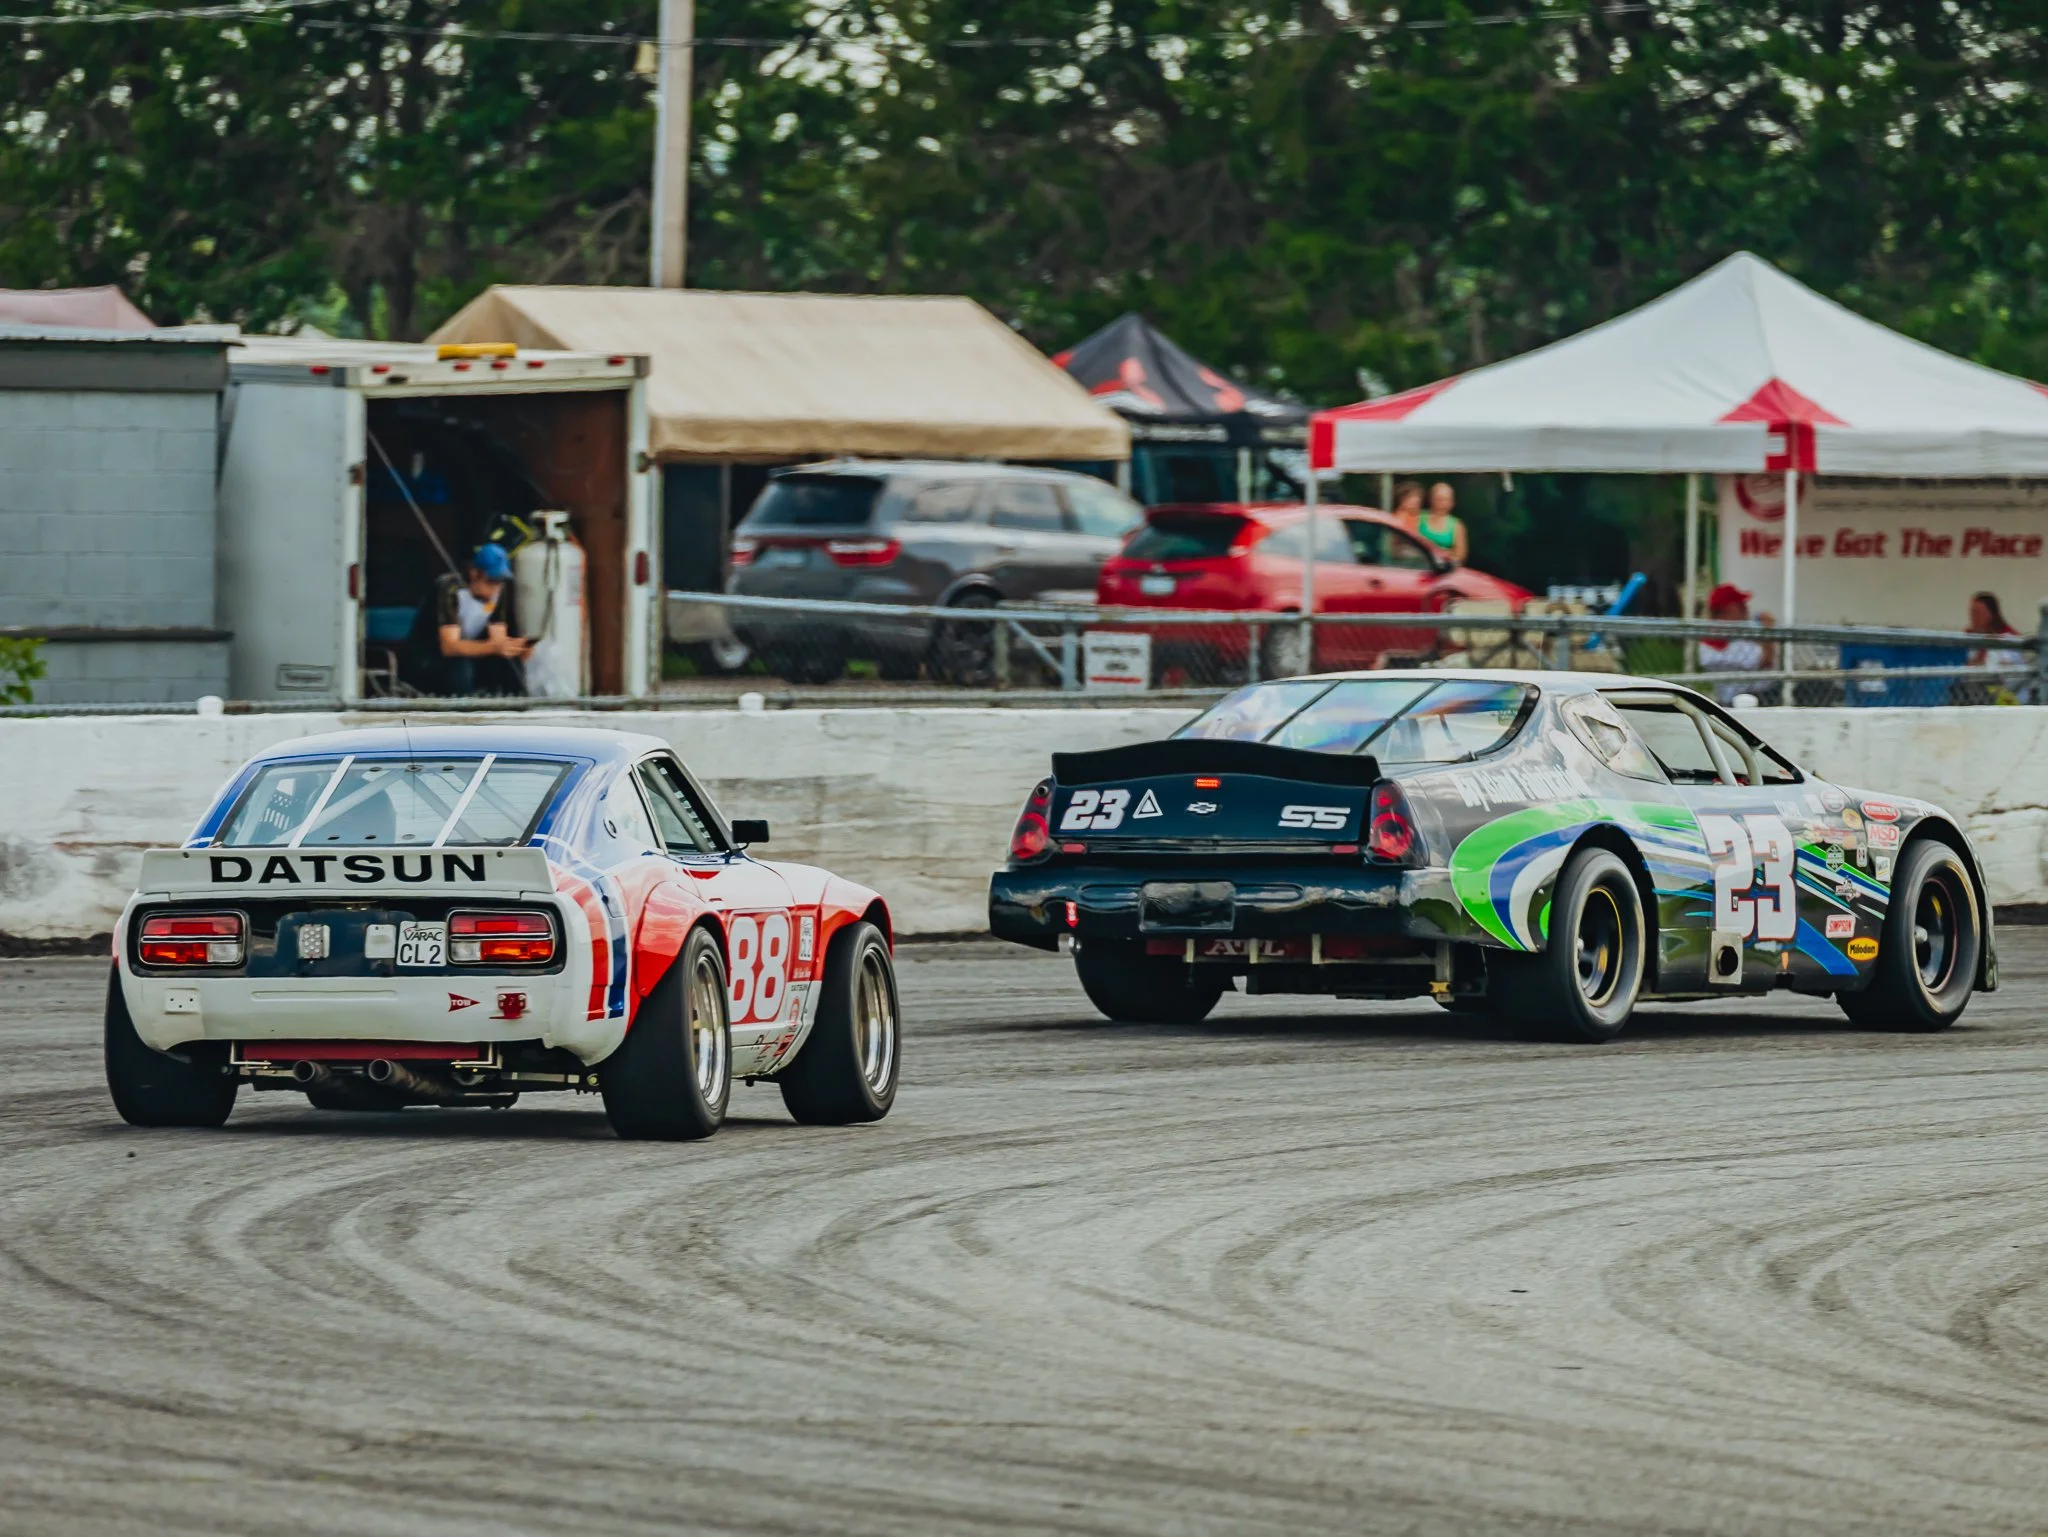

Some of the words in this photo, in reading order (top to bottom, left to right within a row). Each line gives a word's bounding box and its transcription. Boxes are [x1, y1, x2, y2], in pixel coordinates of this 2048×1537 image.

[1833, 527, 1887, 557] Got
[1900, 527, 1952, 557] The
[1960, 527, 2043, 557] Place
[1060, 789, 1131, 830] 23
[1278, 805, 1351, 830] SS
[1869, 826, 1897, 841] MSD
[209, 855, 486, 883] DATSUN
[1697, 814, 1797, 941] 23
[403, 931, 443, 941] VARAC
[400, 943, 425, 964] CL
[429, 944, 441, 964] 2
[728, 914, 789, 1022] 88
[451, 999, 472, 1007] TOW
